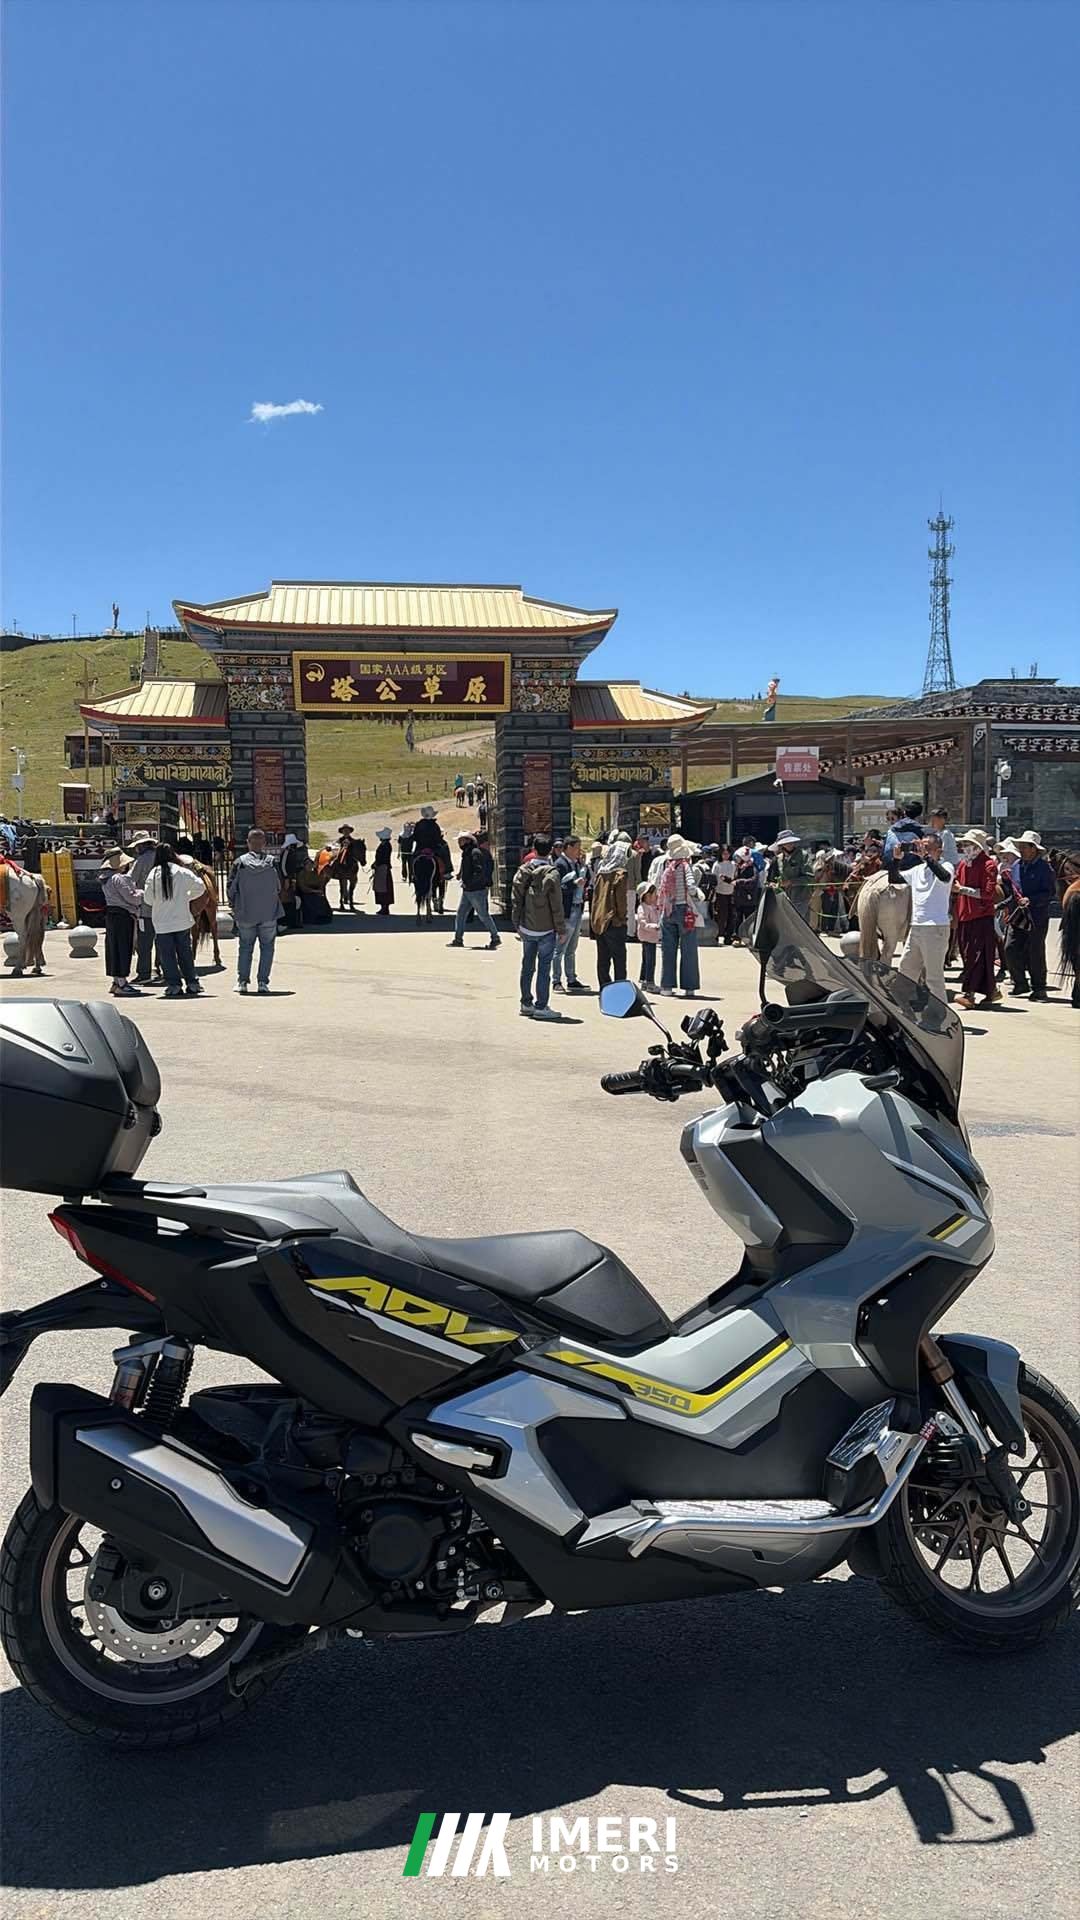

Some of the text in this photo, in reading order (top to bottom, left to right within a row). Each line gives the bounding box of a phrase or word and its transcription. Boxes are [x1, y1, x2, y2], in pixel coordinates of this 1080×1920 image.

[360, 663, 447, 675] 国家AAA级景区
[330, 675, 488, 703] 塔公草原
[304, 1276, 521, 1345] ADV
[633, 1381, 692, 1411] 350
